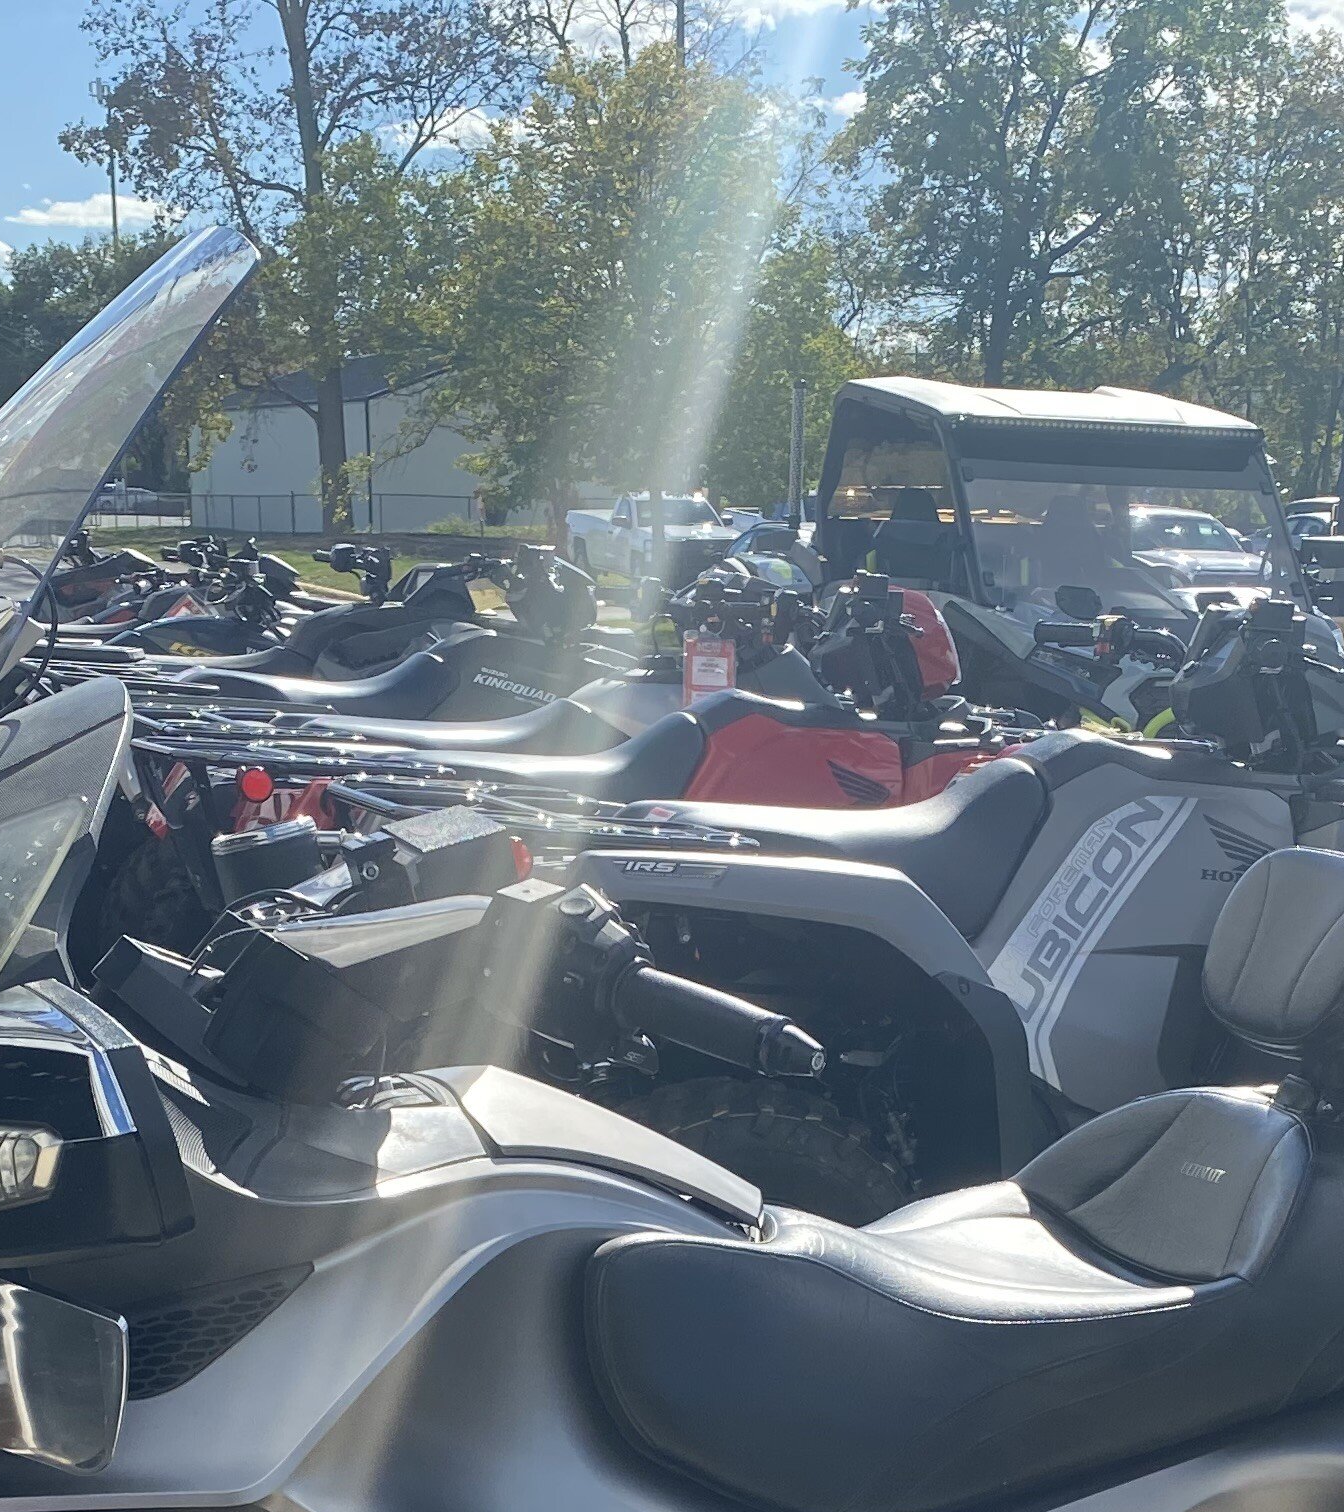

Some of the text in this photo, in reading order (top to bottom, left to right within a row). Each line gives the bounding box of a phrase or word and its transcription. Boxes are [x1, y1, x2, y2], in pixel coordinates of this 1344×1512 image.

[625, 861, 677, 873] IRS
[1012, 799, 1165, 1024] UBICON
[1026, 814, 1115, 939] FOREMAN
